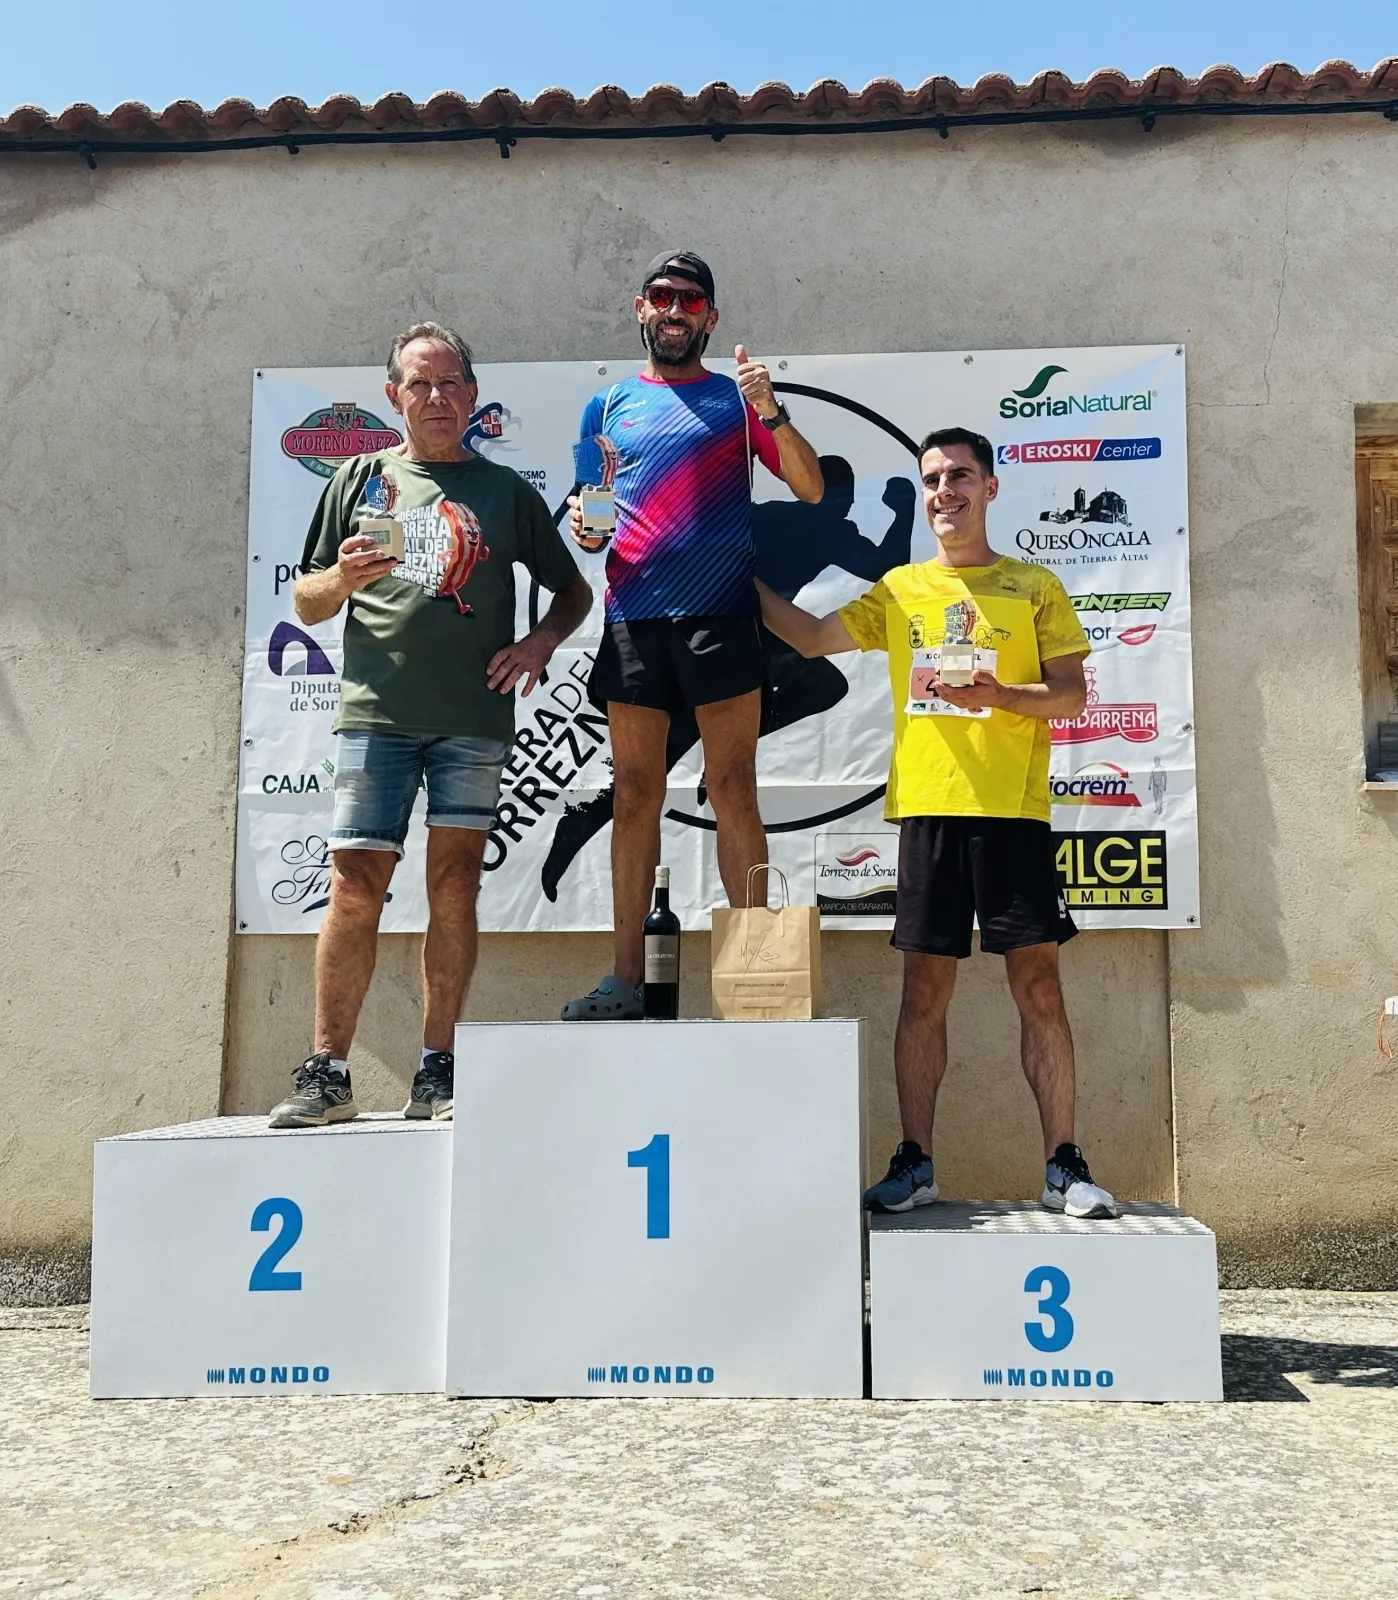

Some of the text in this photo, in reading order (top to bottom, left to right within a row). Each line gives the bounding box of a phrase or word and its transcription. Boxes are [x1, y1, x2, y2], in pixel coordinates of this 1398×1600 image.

[999, 390, 1151, 419] SoriaNatural
[292, 434, 394, 452] MORENO SAEZ
[1025, 443, 1153, 459] EROSKI center
[1021, 553, 1149, 566] NATURAL DE TIERRAS ALTAS
[290, 680, 342, 697] Diputa
[290, 696, 338, 711] de Sor
[262, 774, 320, 795] CAJA
[1055, 837, 1162, 884] ALGE
[818, 863, 896, 881] Torrezno de Soria
[1066, 889, 1155, 903] IMING
[820, 902, 846, 911] MARCA
[847, 902, 857, 911] DE
[627, 1134, 670, 1239] 1
[248, 1197, 303, 1291] 2
[1024, 1265, 1074, 1353] 3
[228, 1366, 329, 1384] MONDO
[610, 1365, 715, 1384] MONDO
[1007, 1368, 1114, 1387] MONDO
